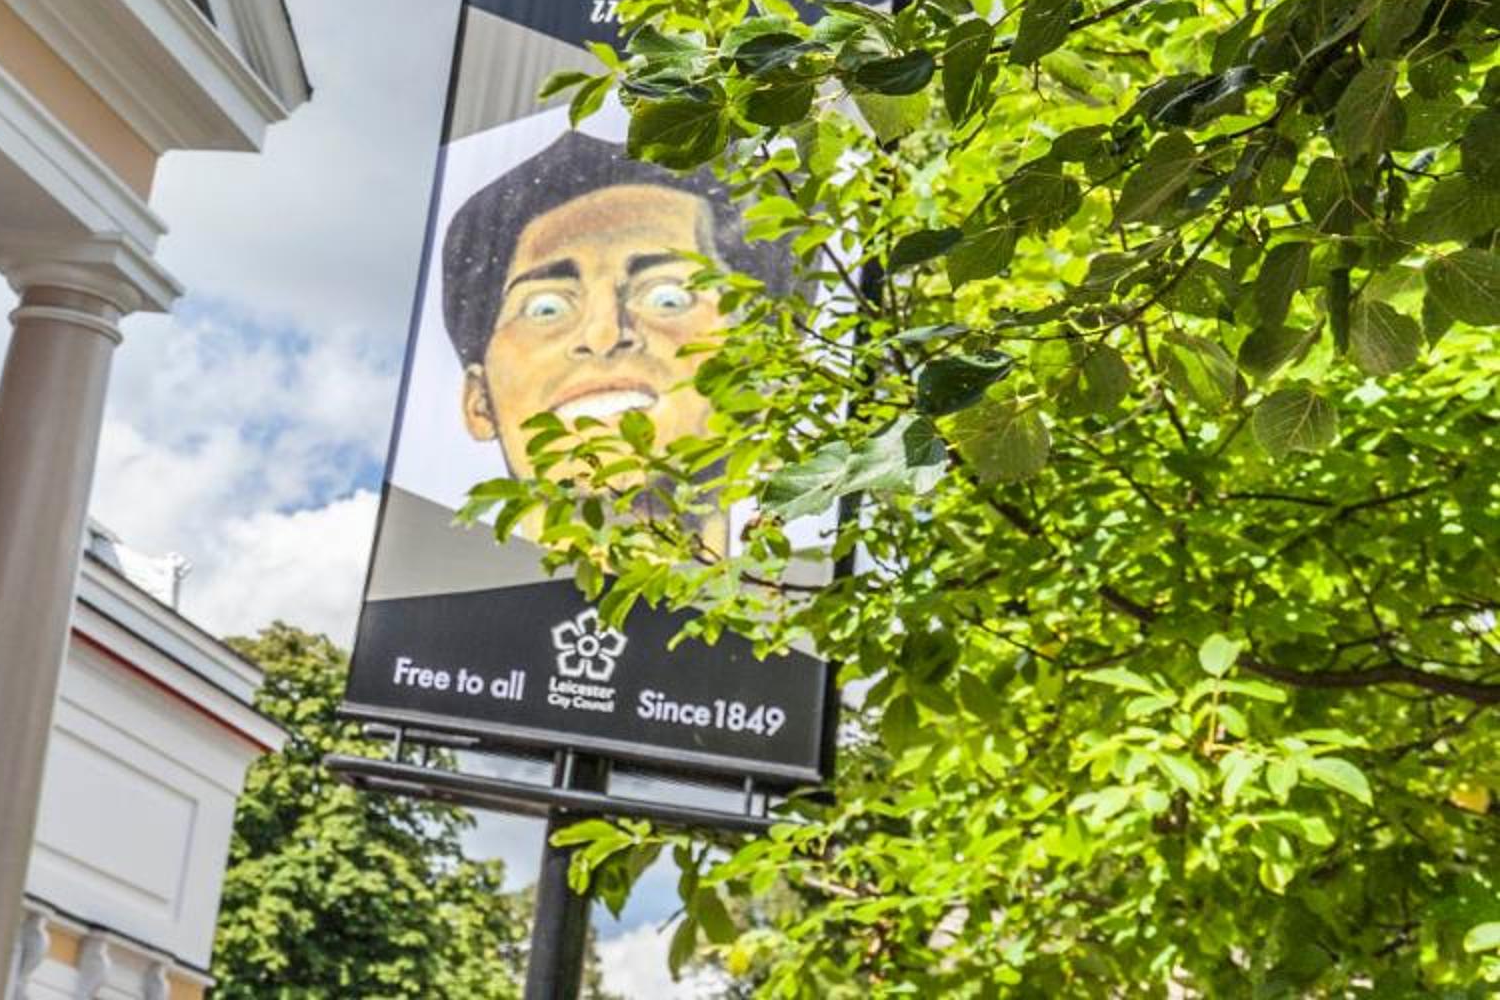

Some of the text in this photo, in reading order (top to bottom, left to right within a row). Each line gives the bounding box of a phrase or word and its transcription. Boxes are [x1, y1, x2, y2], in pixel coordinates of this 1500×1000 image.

[393, 657, 526, 700] Free to all
[548, 676, 616, 698] Leicester
[573, 696, 615, 713] Council
[636, 689, 786, 736] Since 1849
